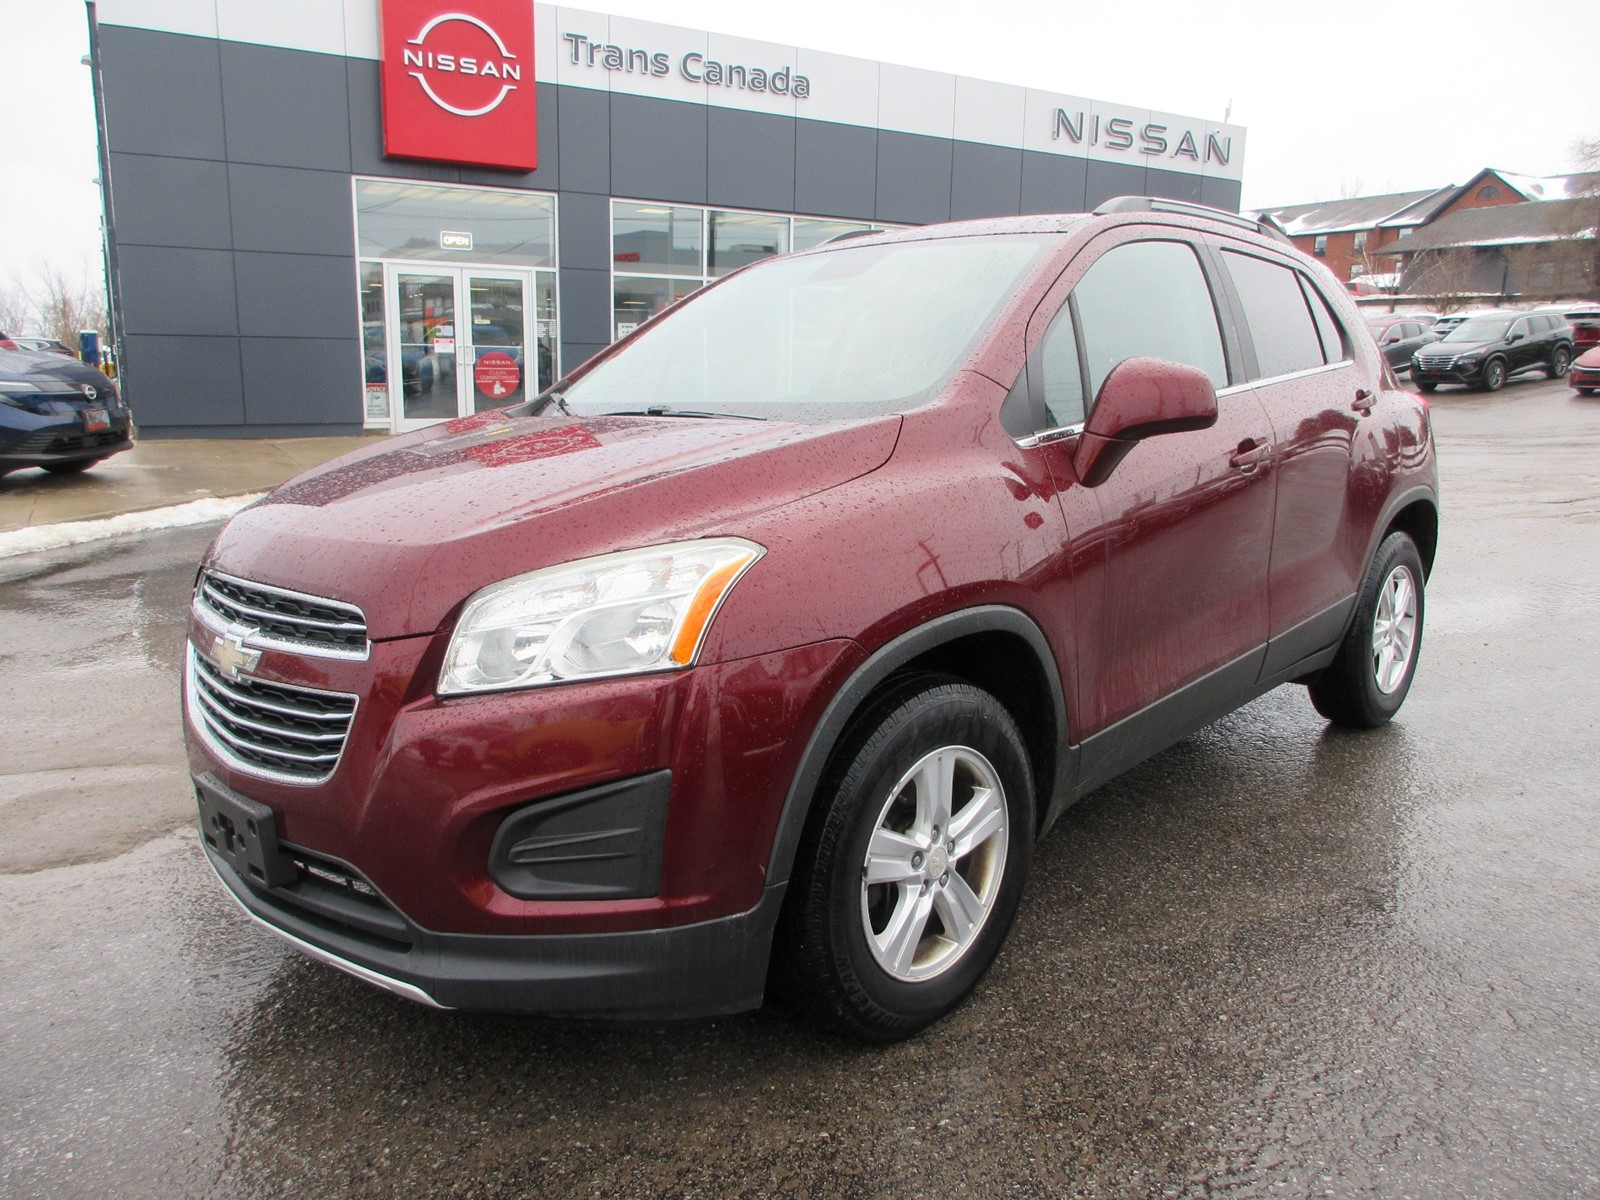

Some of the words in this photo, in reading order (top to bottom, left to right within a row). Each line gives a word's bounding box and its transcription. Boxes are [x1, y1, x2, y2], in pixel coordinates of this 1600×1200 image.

[403, 48, 520, 81] NISSAN
[563, 32, 670, 76] Trans
[680, 51, 811, 98] Canada
[1053, 107, 1232, 165] NISSAN
[443, 236, 469, 246] OPEN
